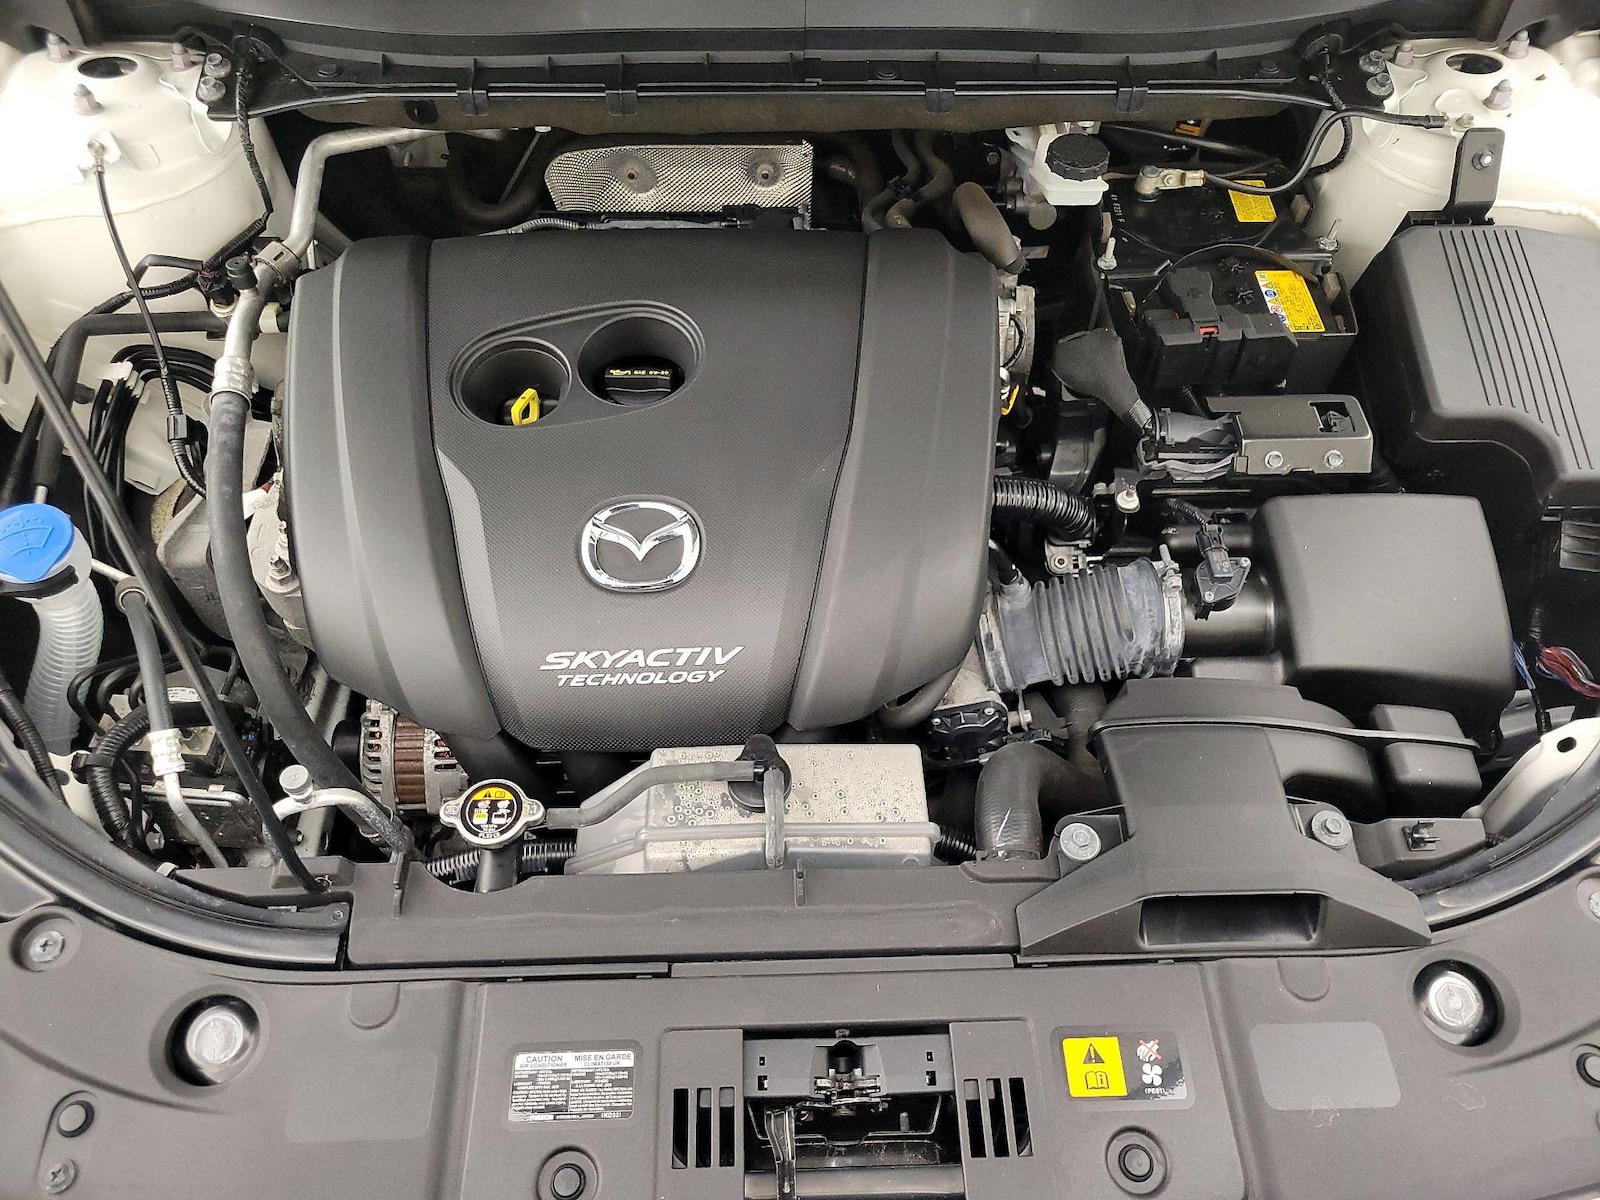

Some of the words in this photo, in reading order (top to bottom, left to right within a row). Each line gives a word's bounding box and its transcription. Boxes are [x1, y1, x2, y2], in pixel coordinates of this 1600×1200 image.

[539, 646, 745, 671] SKYACTIV
[557, 669, 727, 687] TECHNOLOGY
[526, 1055, 563, 1063] CAUTION
